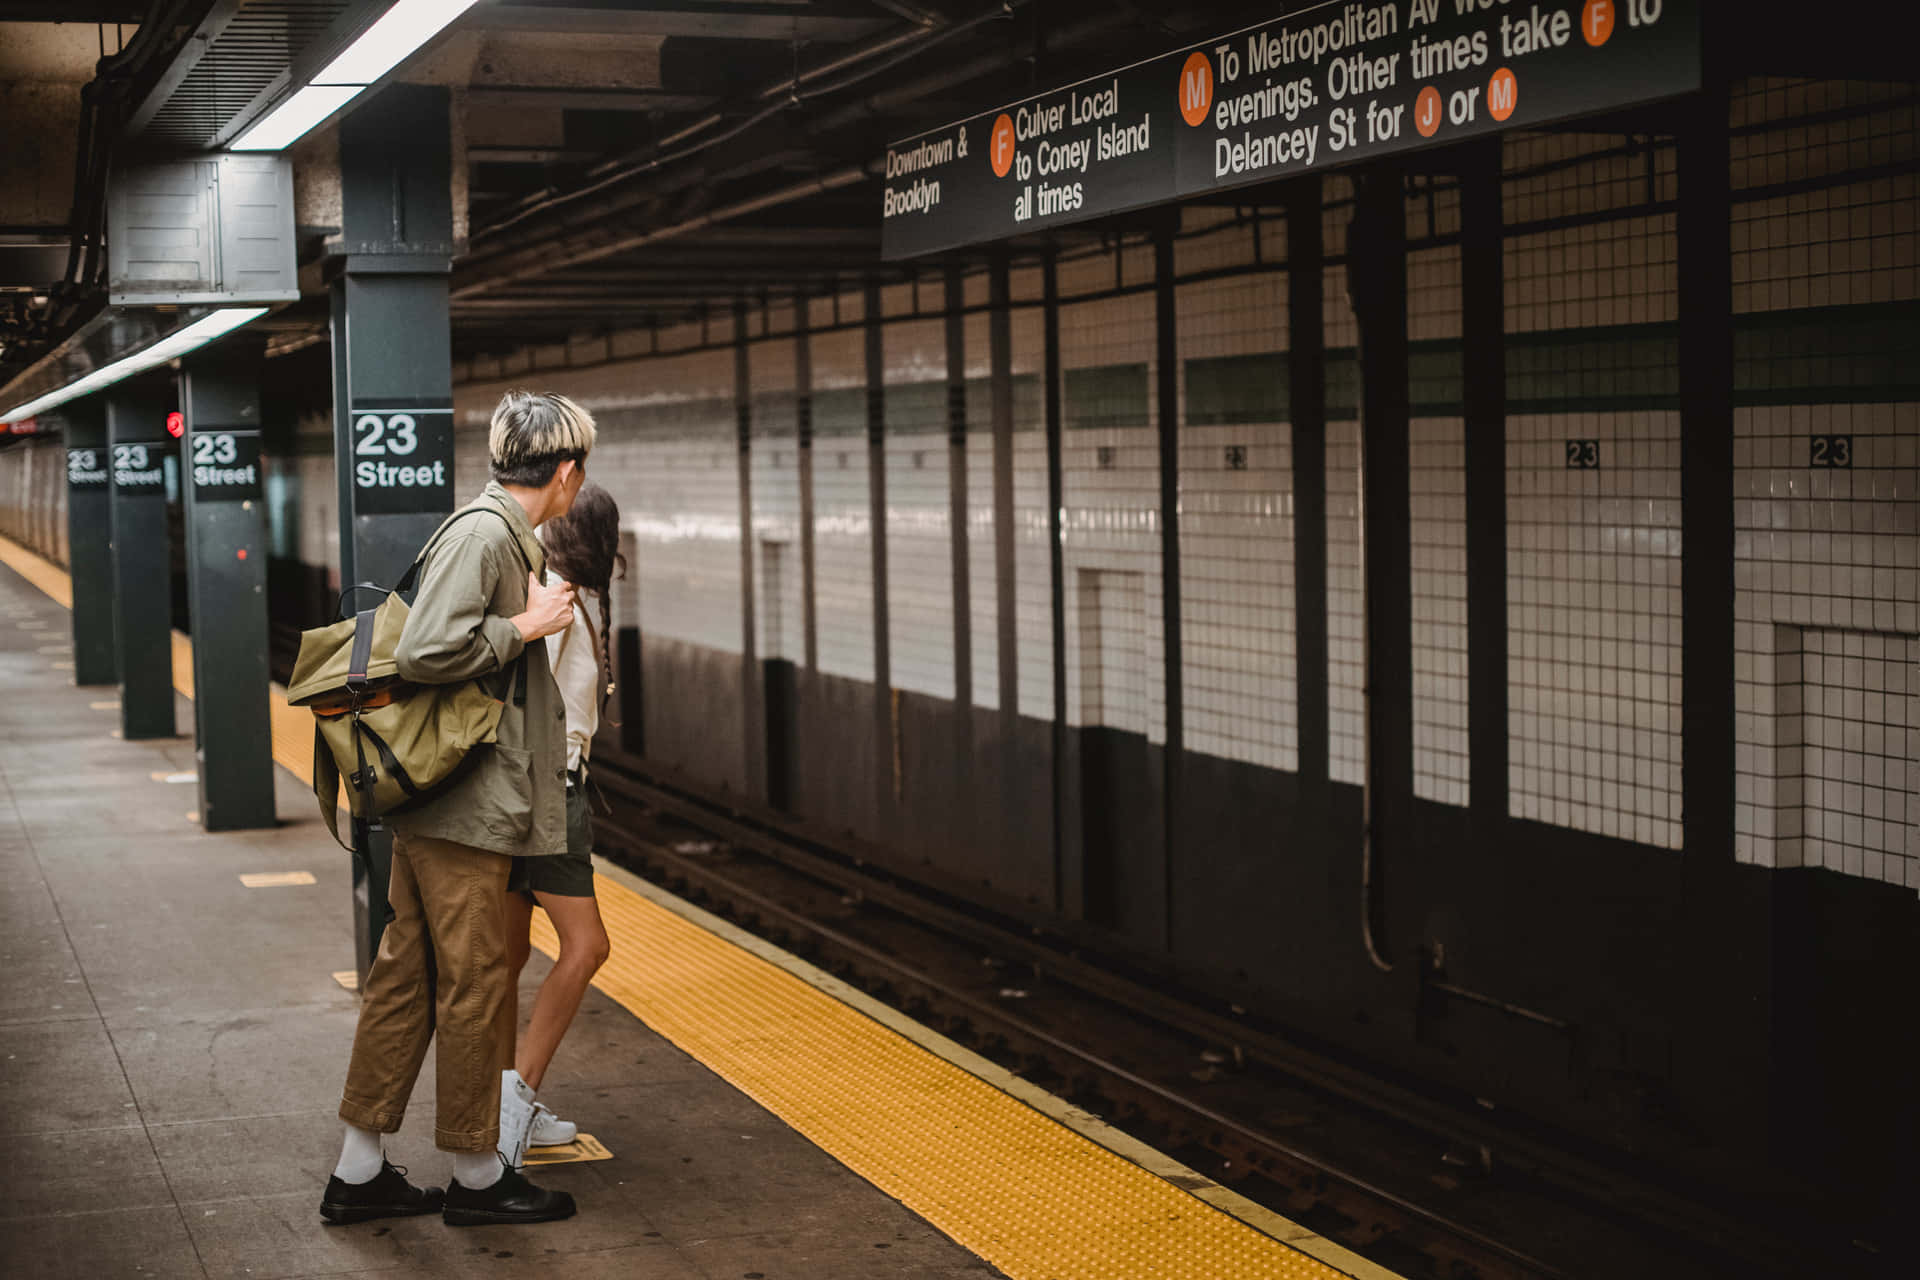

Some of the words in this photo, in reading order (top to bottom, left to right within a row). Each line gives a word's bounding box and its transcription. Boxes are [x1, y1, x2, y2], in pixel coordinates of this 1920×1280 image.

[1215, 44, 1240, 83] To
[1248, 2, 1398, 75] Metropolitan
[1408, 0, 1440, 29] Av
[1216, 77, 1319, 130] evenings.
[1328, 52, 1400, 101] Other
[1410, 30, 1488, 80] times
[1500, 5, 1571, 58] take
[1591, 3, 1606, 37] F
[1627, 0, 1662, 27] to
[1186, 67, 1206, 111] M
[1016, 101, 1066, 142] Culver
[1071, 79, 1119, 126] Local
[1216, 125, 1319, 178] Delancey
[1329, 107, 1357, 151] St
[1366, 100, 1405, 142] for
[1422, 97, 1433, 126] J
[1449, 86, 1480, 125] or
[1492, 77, 1512, 111] M
[886, 138, 953, 180] Downtown
[957, 126, 968, 158] &
[997, 129, 1009, 165] F
[1016, 151, 1032, 181] to
[1037, 137, 1091, 176] Coney
[1097, 113, 1150, 161] Island
[884, 180, 940, 218] Brooklyn
[1015, 186, 1032, 222] all
[1038, 182, 1083, 216] times
[193, 435, 237, 464] 23
[355, 414, 418, 455] 23
[1812, 438, 1850, 466] 23
[68, 450, 96, 470] 23
[114, 445, 148, 469] 23
[356, 460, 445, 487] Street
[1567, 442, 1598, 467] 23
[194, 464, 255, 486] Street
